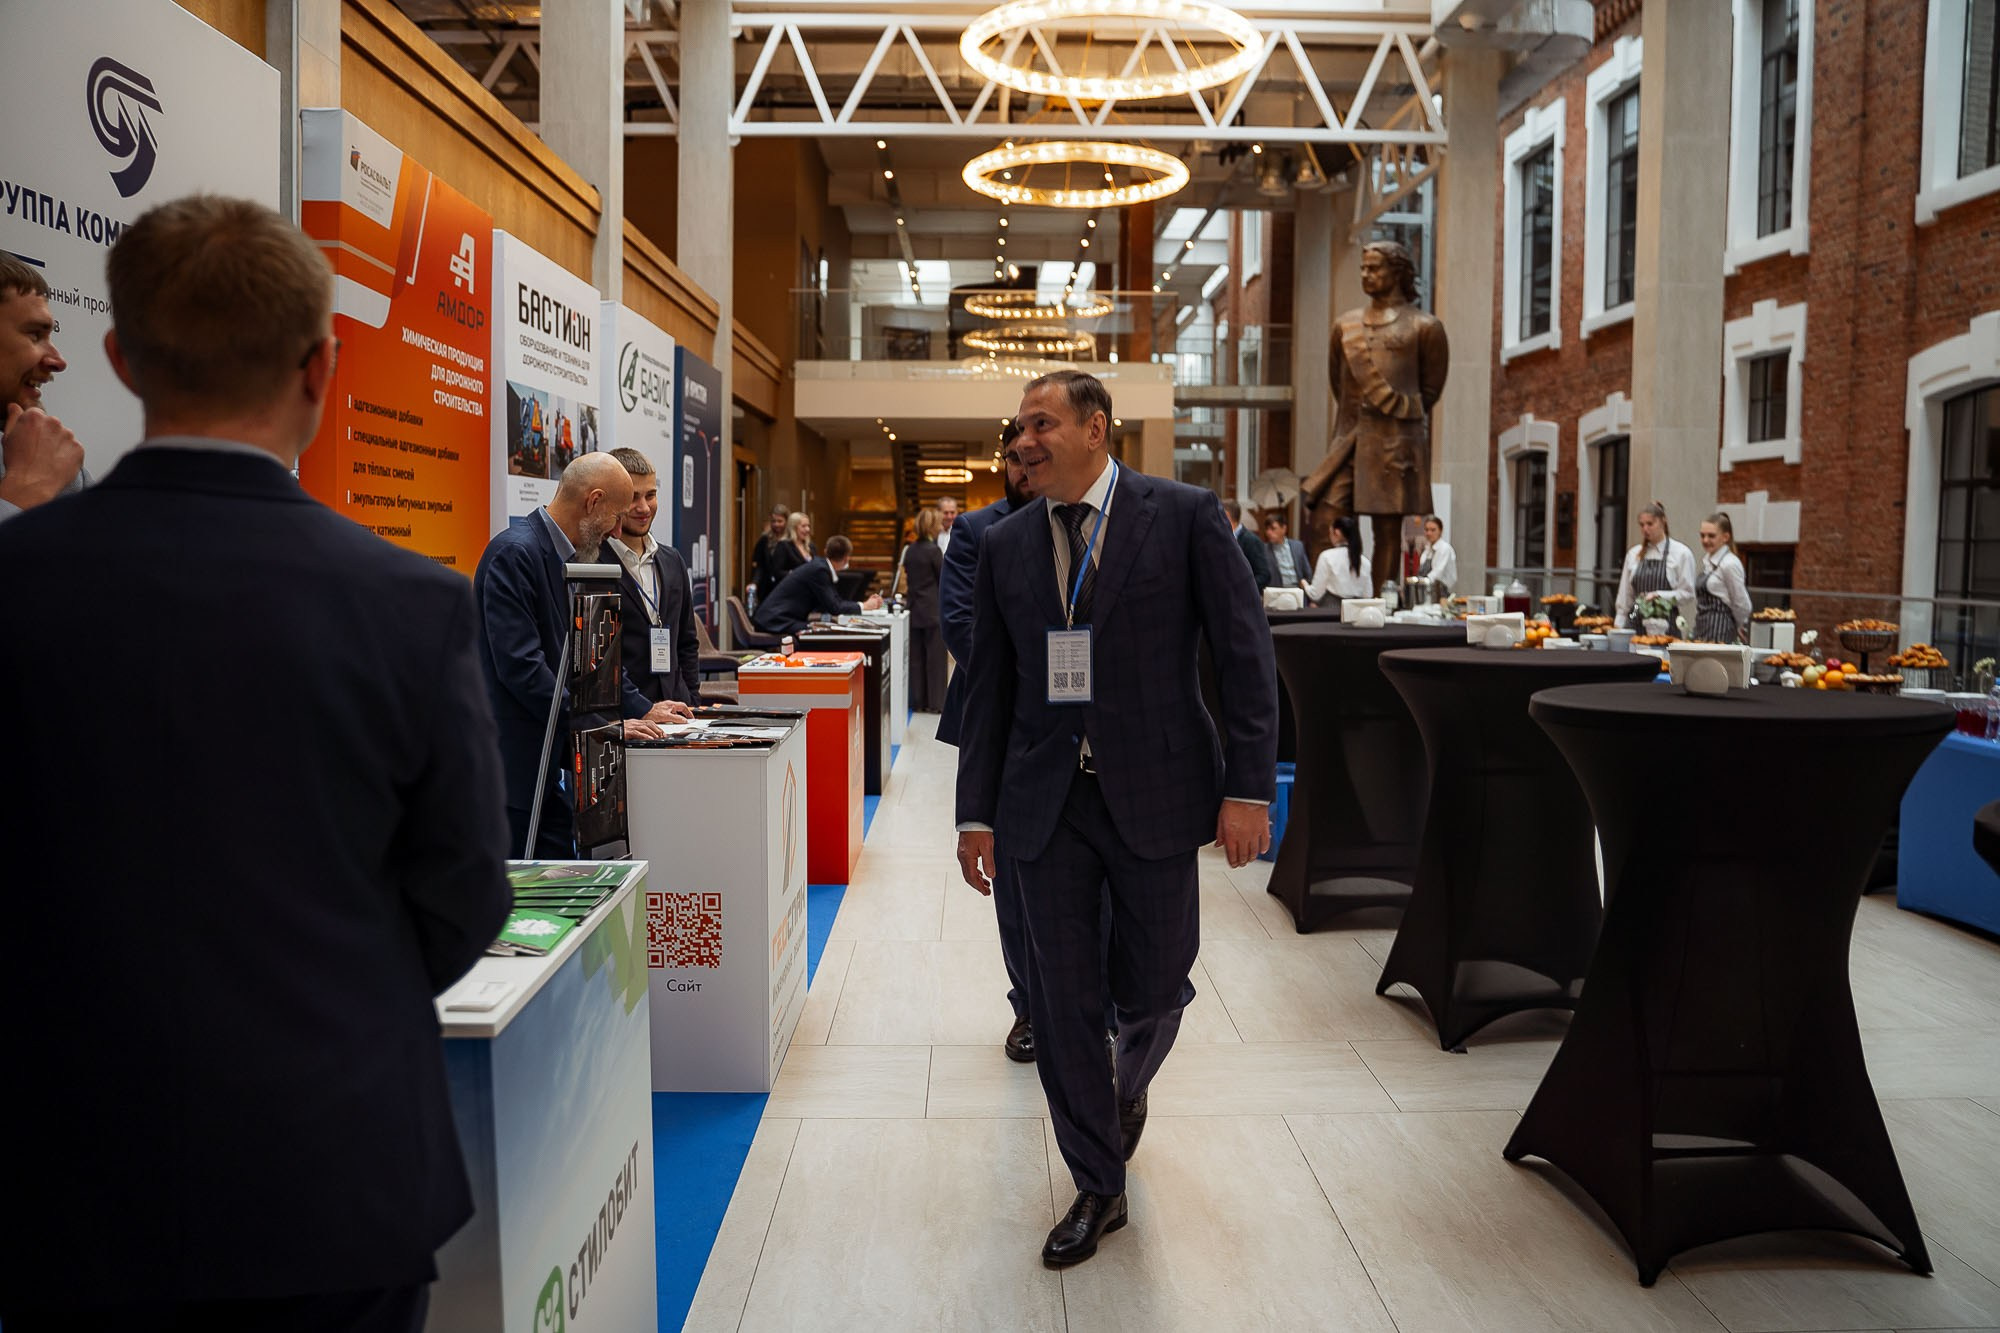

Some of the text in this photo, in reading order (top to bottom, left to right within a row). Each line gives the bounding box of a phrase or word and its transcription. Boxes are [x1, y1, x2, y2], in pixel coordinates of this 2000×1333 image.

[437, 291, 485, 331] АМДОР
[518, 281, 591, 353] БАСТИОН
[402, 326, 484, 372] ХИМИЧЕСКАЯ ПРОДУКЦИЯ
[431, 364, 484, 394] ДЛЯ ДОРОЖНОГО
[434, 390, 484, 416] СТРОИТЕЛЬСТВА
[353, 462, 366, 475] для
[666, 978, 702, 993] Сайт
[568, 1139, 639, 1321] СТИЛОБИТ
